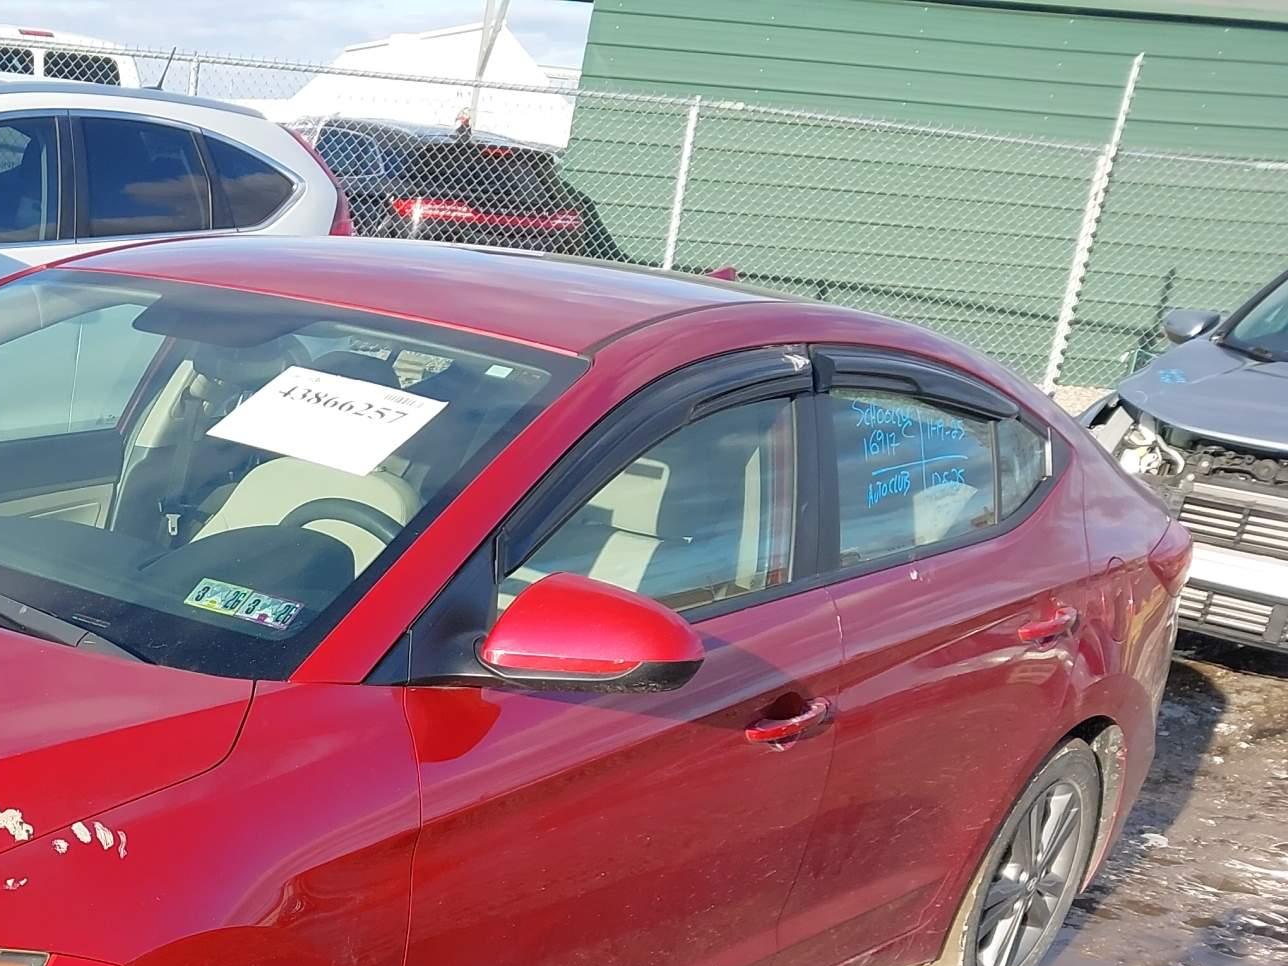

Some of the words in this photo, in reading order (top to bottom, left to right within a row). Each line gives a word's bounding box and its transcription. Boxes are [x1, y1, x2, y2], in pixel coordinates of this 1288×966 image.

[278, 385, 408, 424] 43866257
[195, 586, 210, 601] 3
[223, 590, 247, 610] 26
[244, 599, 261, 614] 3
